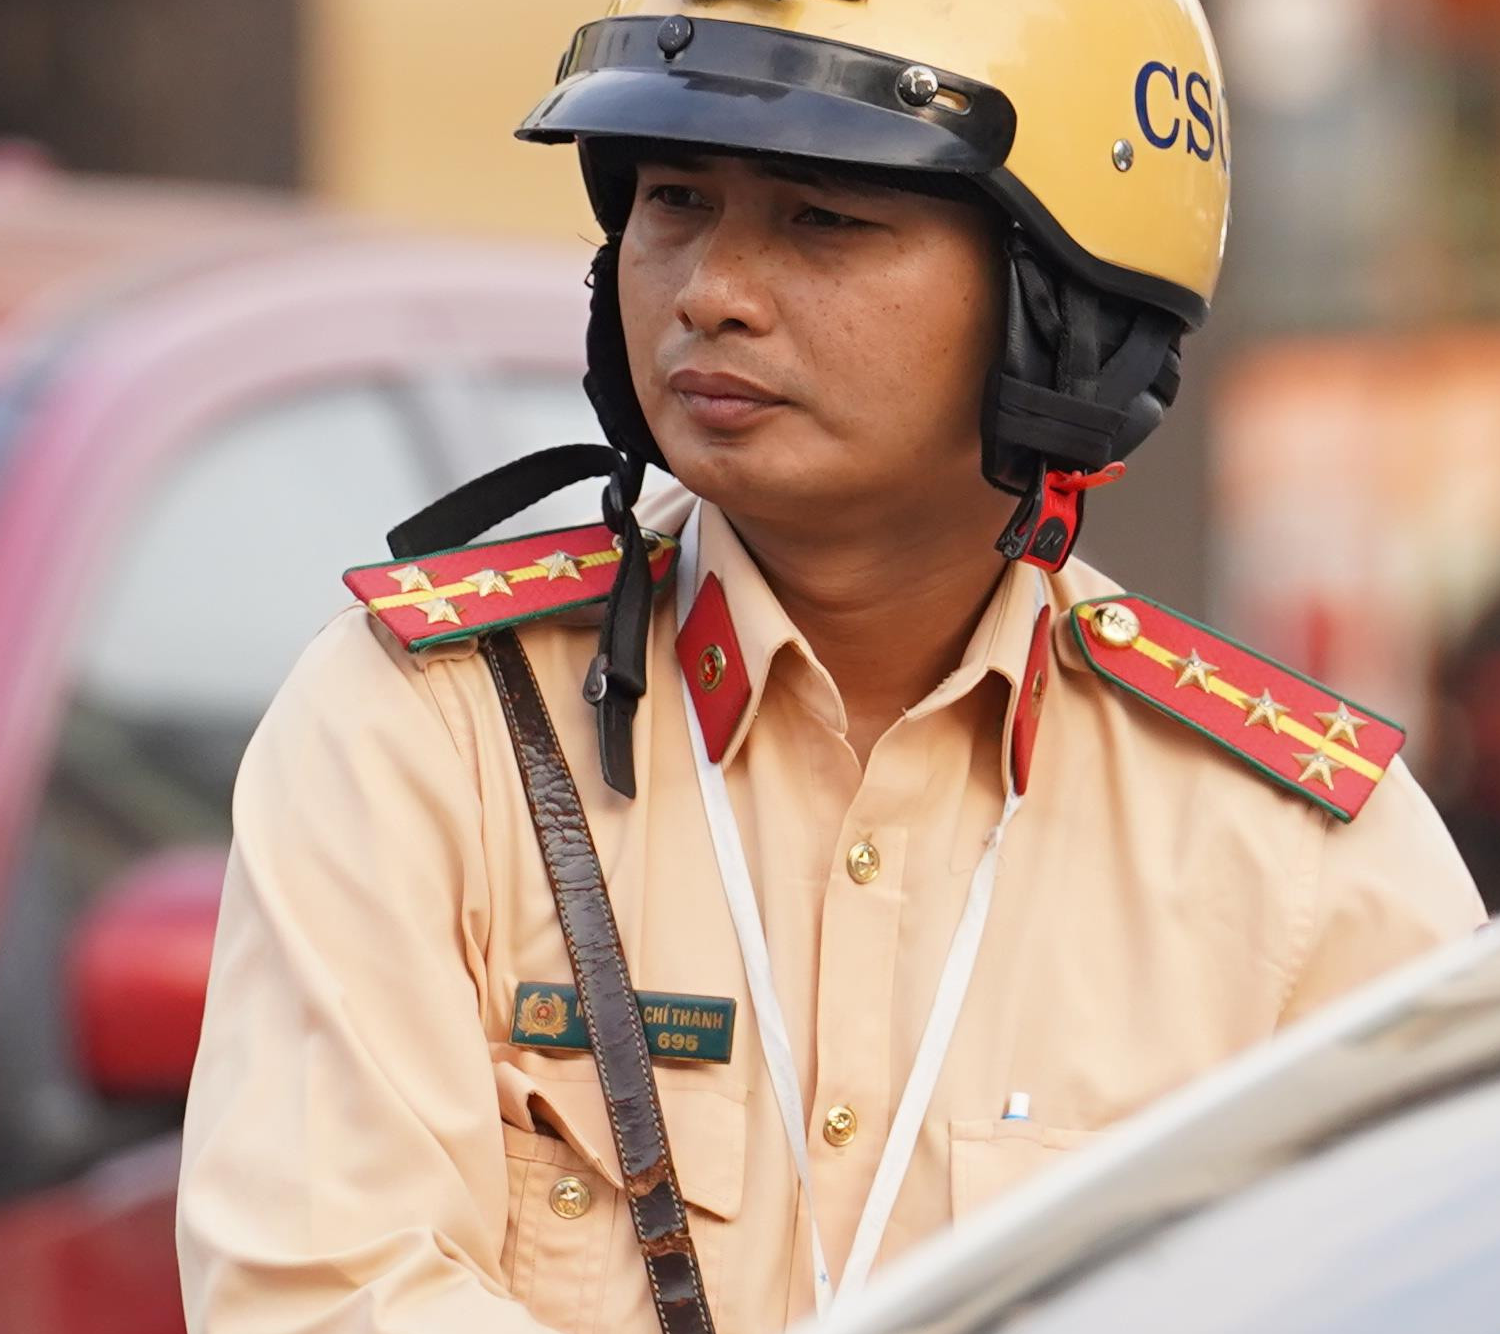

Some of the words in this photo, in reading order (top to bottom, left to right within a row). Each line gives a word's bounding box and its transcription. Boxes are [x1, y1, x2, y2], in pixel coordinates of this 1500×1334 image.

[643, 1003, 669, 1025] CHÍ
[671, 1007, 724, 1029] THÀNH
[657, 1031, 700, 1052] 695
